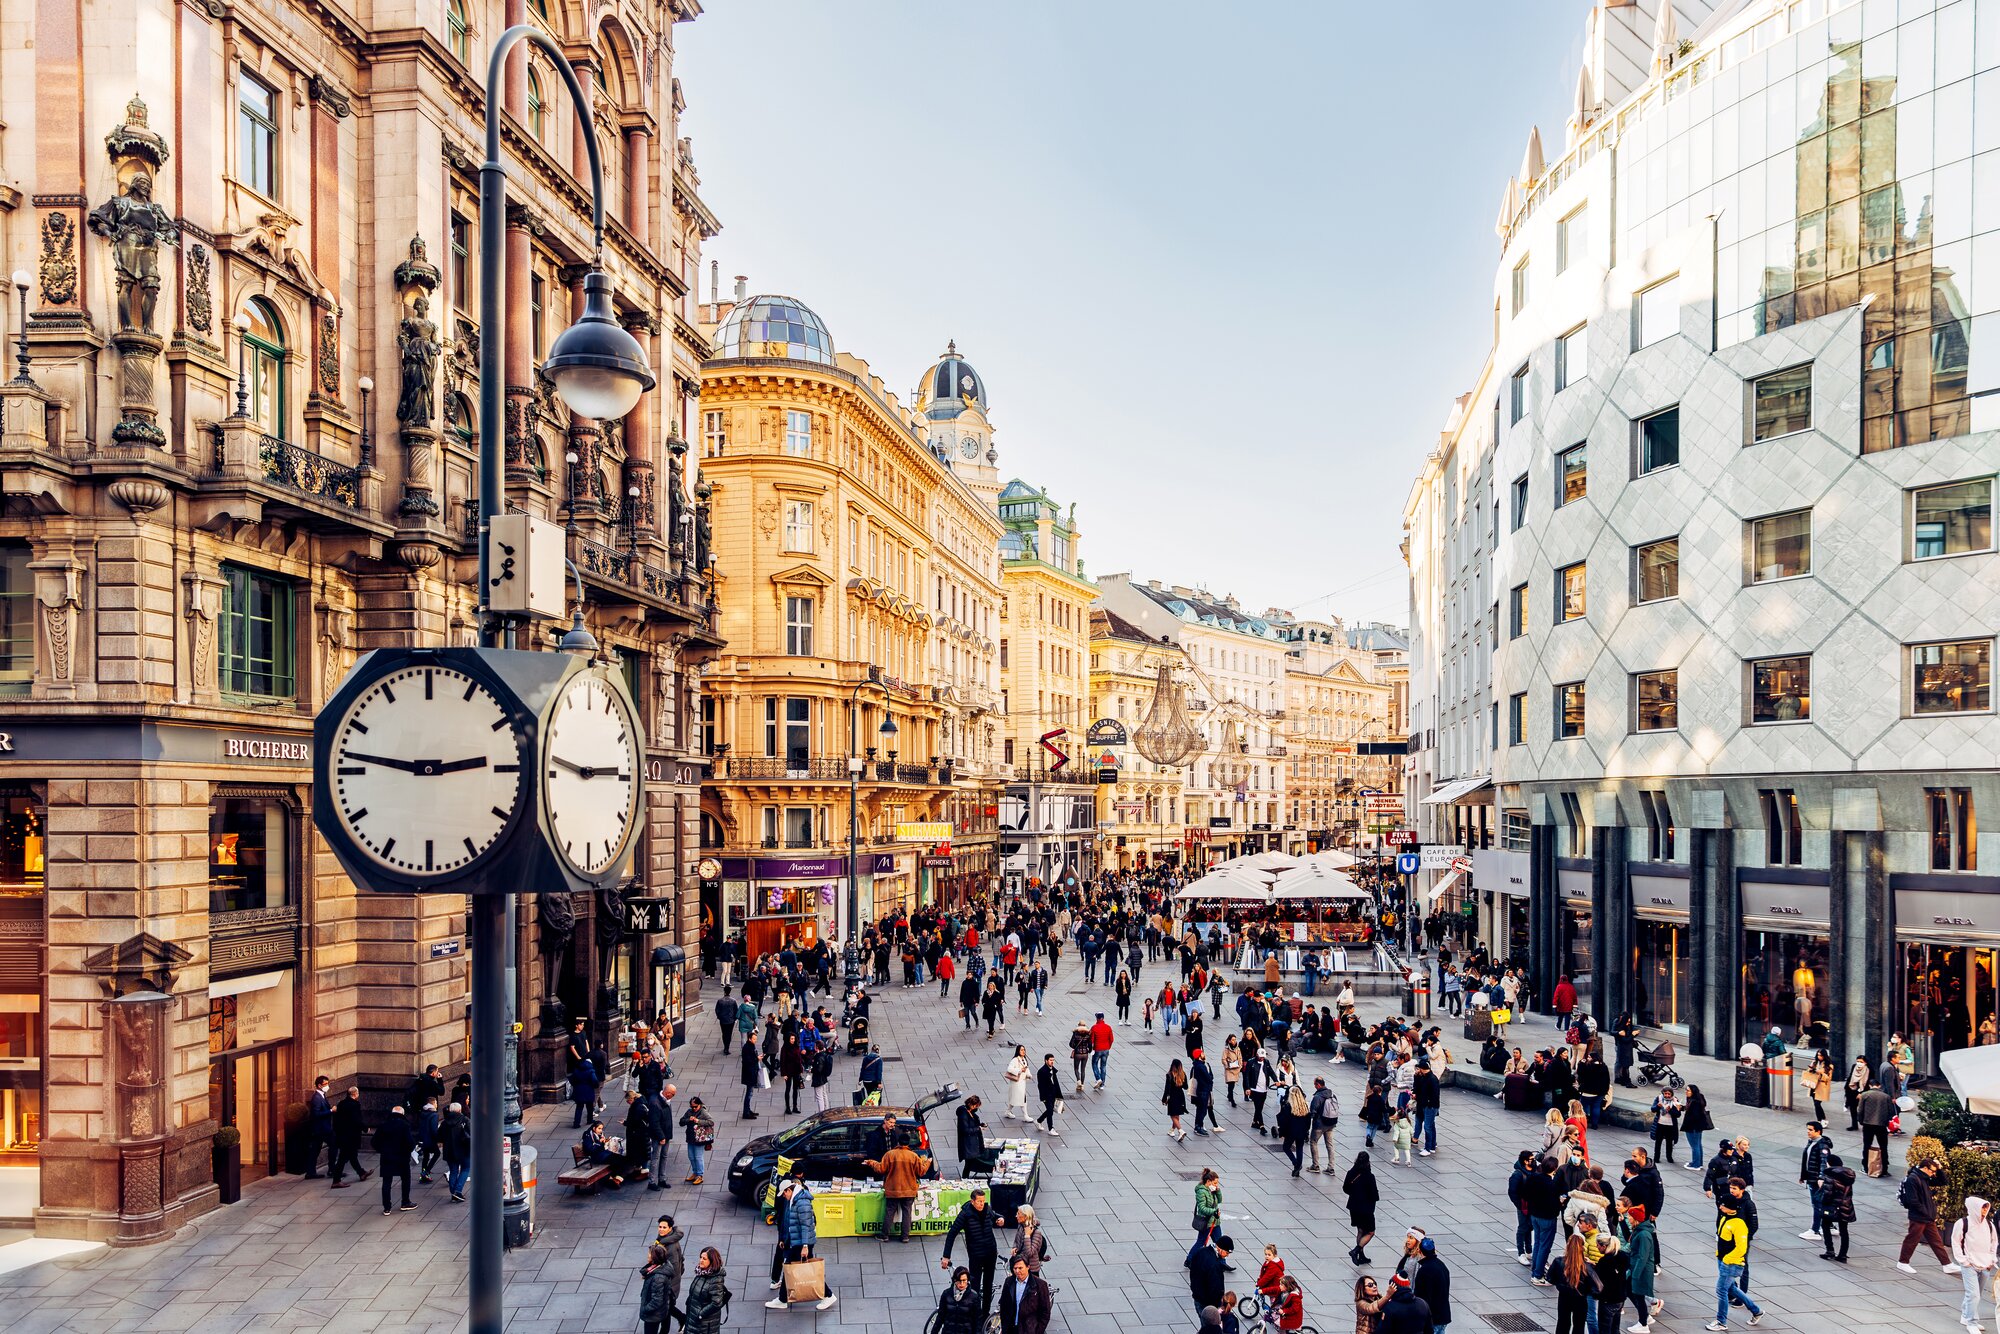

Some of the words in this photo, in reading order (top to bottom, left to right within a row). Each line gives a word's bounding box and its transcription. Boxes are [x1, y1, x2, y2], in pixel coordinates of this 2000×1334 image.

[227, 738, 310, 760] BUCHERER
[1184, 828, 1212, 842] LISKA
[788, 862, 825, 873] Marionnaud
[1402, 858, 1416, 872] U
[1650, 897, 1675, 906] ZARA
[1769, 905, 1802, 915] ZARA
[1933, 915, 1976, 926] ZARA
[230, 941, 280, 959] BUCHERER
